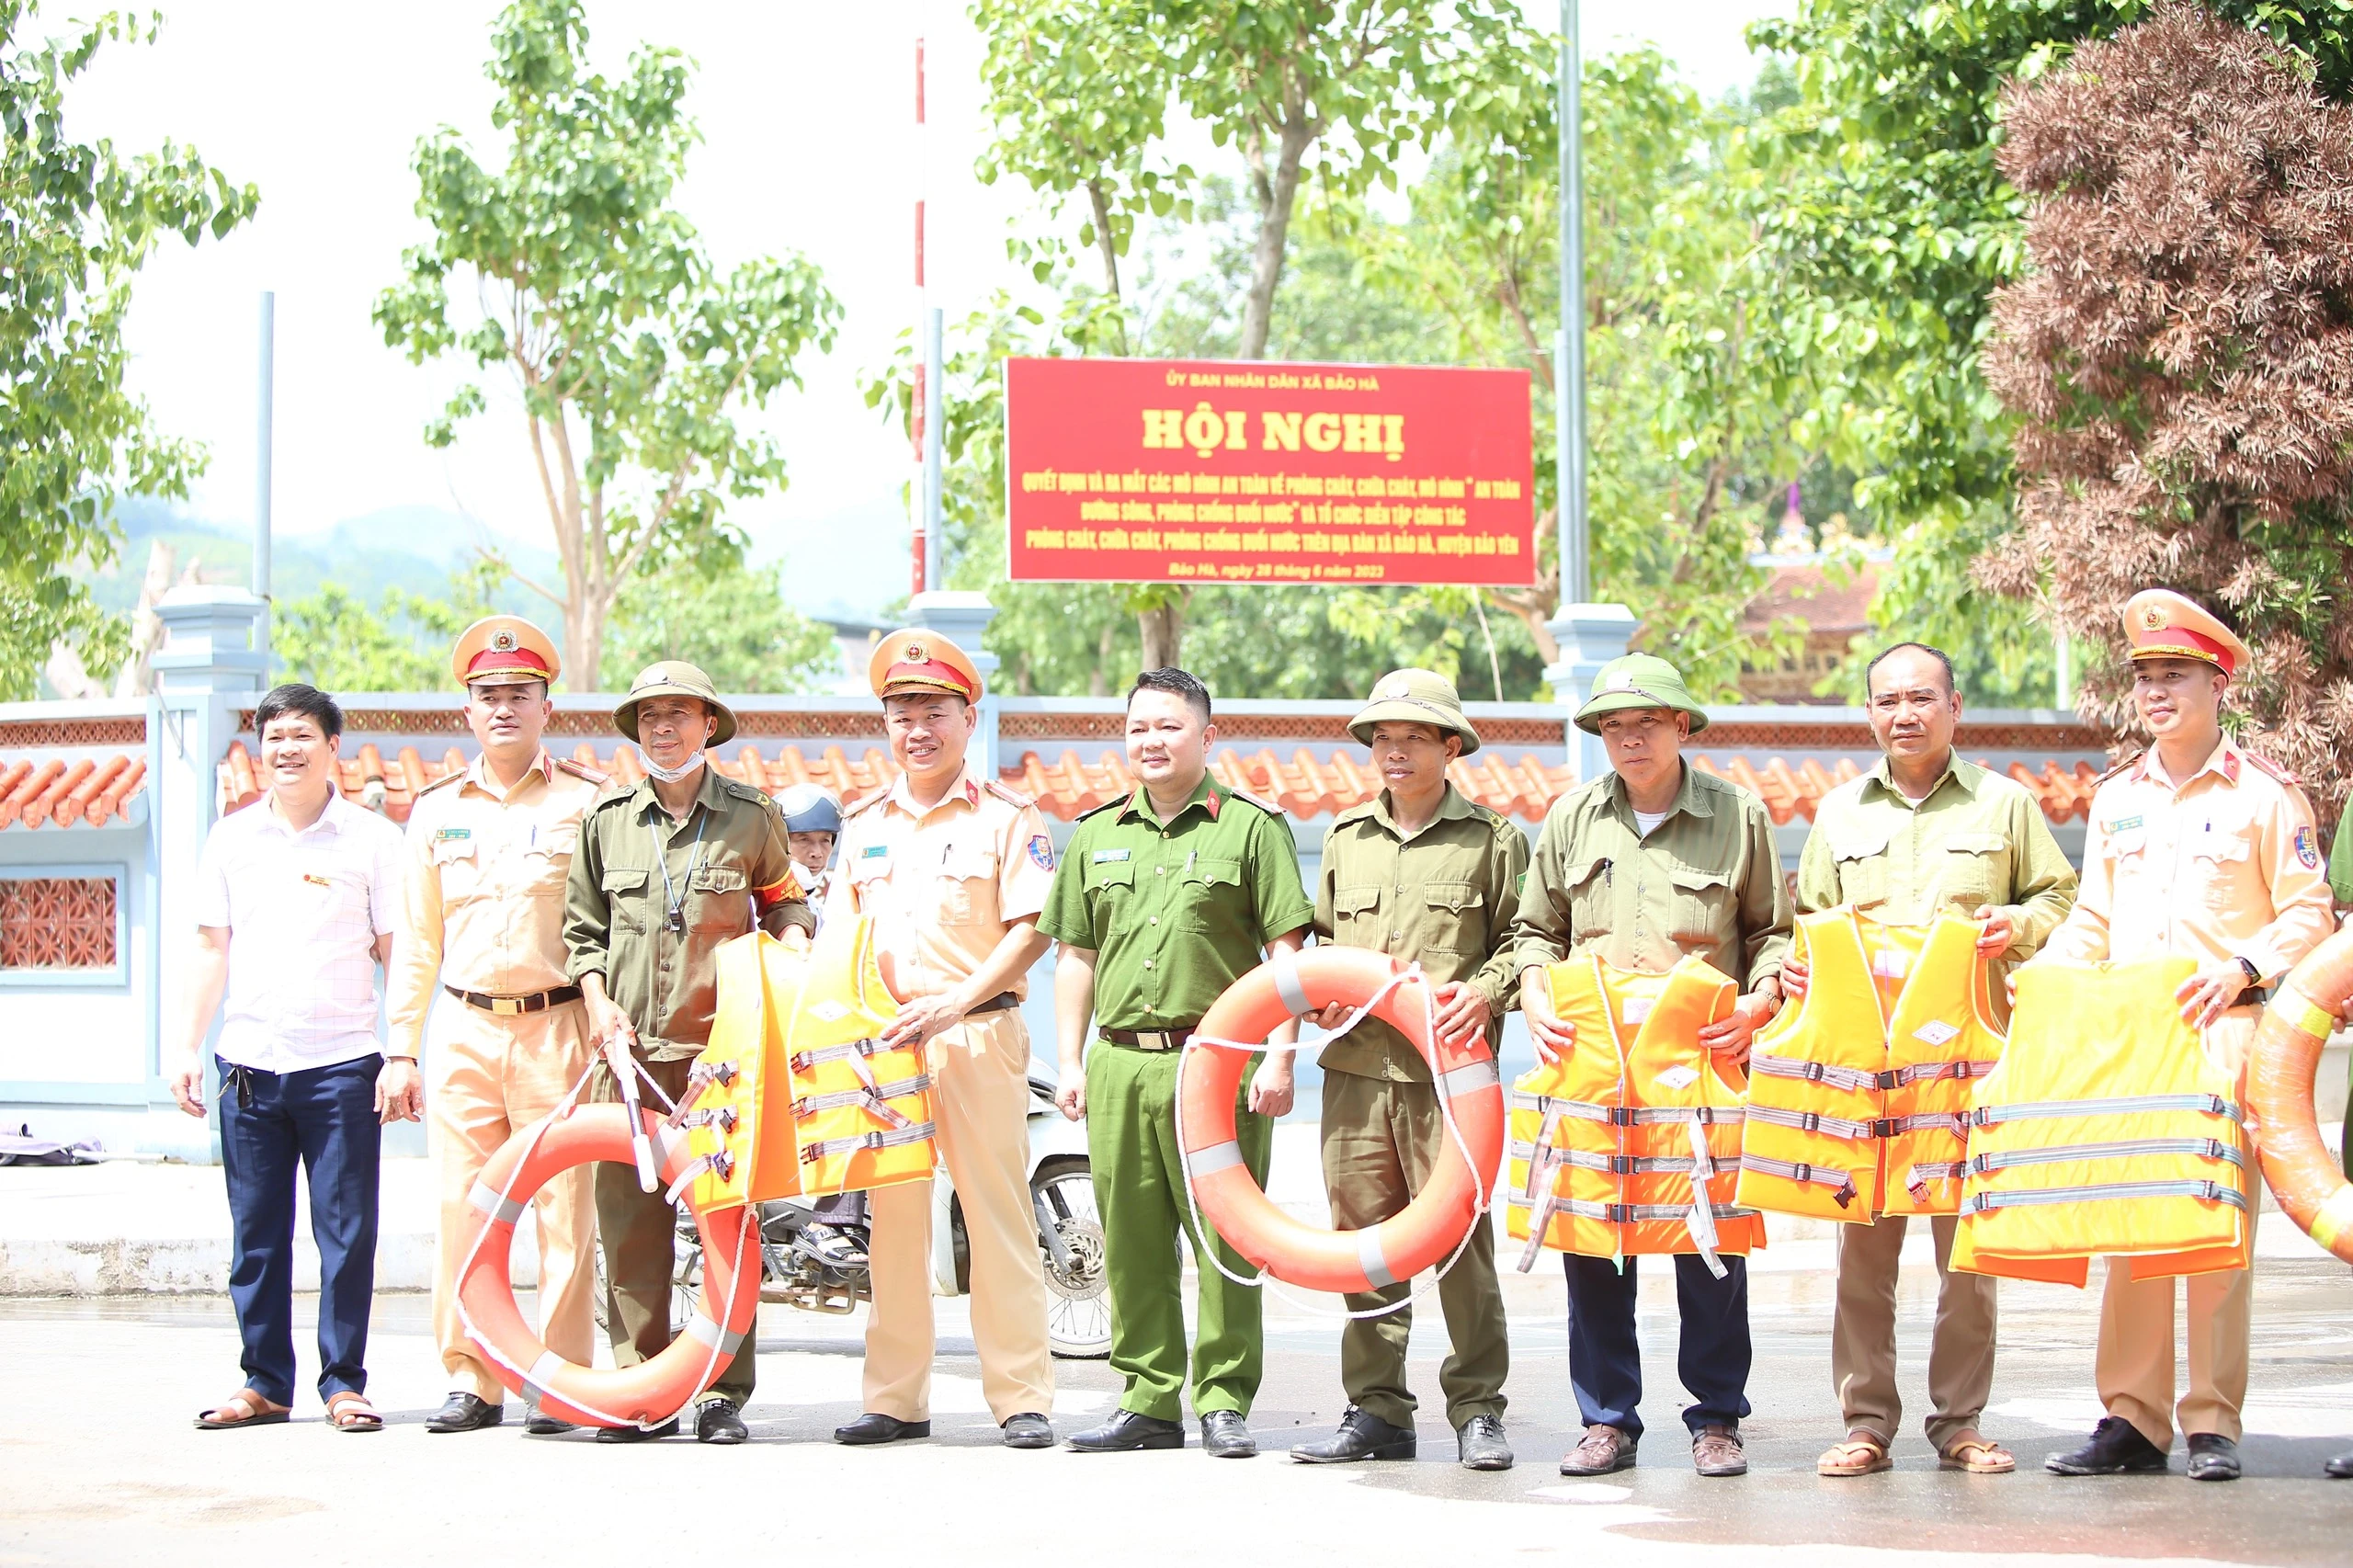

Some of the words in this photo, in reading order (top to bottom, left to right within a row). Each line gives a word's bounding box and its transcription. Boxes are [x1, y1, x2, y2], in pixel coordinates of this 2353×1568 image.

[1166, 369, 1187, 386] ỦY
[1189, 373, 1221, 387] BAN
[1223, 372, 1265, 388] NHÂN
[1267, 373, 1299, 389] DÂN
[1324, 373, 1357, 391] BẢO
[1358, 376, 1379, 391] HÀ
[1142, 402, 1247, 458] HỘI
[1262, 412, 1404, 461] NGHỊ
